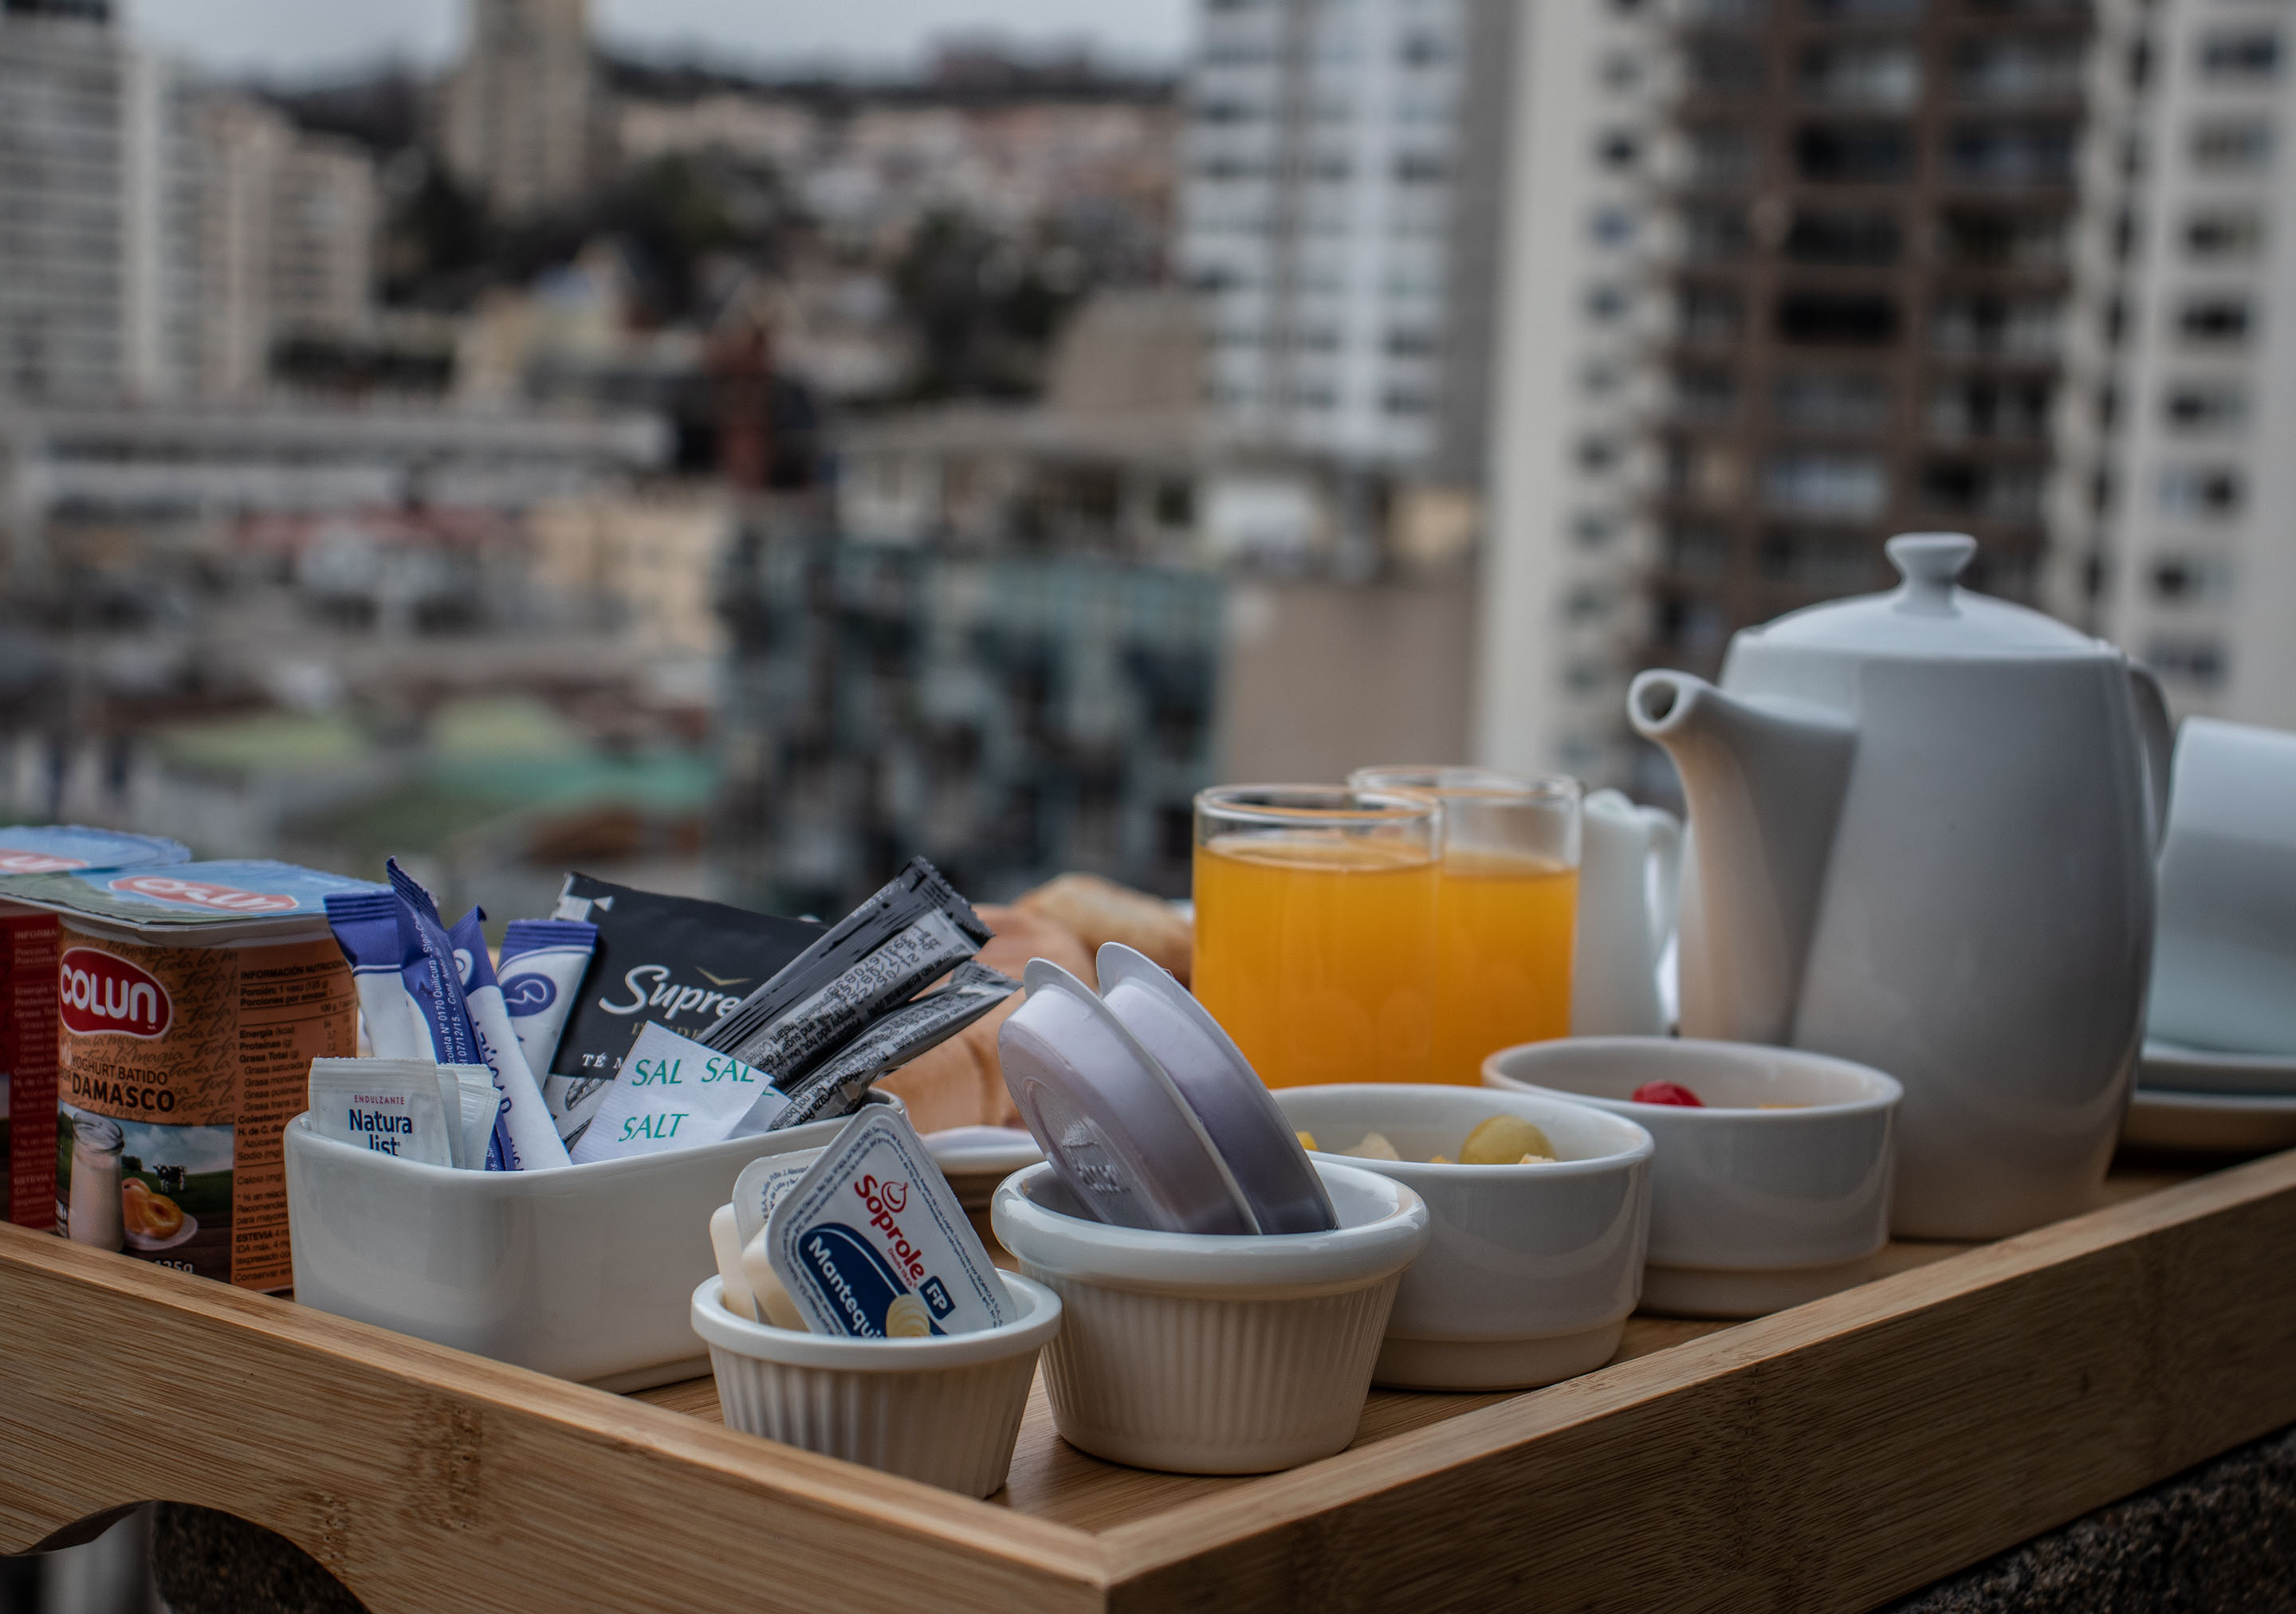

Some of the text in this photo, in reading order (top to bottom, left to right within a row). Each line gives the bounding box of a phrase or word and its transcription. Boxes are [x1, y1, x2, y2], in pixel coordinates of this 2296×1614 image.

[14, 929, 57, 940] INFORMA
[241, 966, 303, 980] INFORMACIÓN
[429, 960, 443, 999] Quilicura
[61, 964, 156, 1023] COLUN
[240, 986, 276, 996] Porción:
[240, 998, 284, 1007] Porciones
[434, 999, 448, 1022] 0170
[239, 1027, 273, 1039] Energía
[769, 1020, 799, 1046] Instant
[798, 1020, 818, 1039] and
[776, 1029, 802, 1053] sugar
[239, 1054, 266, 1063] Grasa
[268, 1051, 288, 1060] Total
[582, 1052, 606, 1068] TÉ
[743, 1039, 774, 1066] Coffee
[72, 1053, 118, 1079] YOGHURT
[119, 1066, 167, 1085] BATIDO
[244, 1066, 269, 1075] Grasa
[631, 1058, 682, 1086] SAL
[702, 1057, 755, 1083] SAL
[244, 1078, 269, 1087] Grasa
[72, 1072, 175, 1113] DAMASCO
[244, 1090, 269, 1100] Grasa
[354, 1094, 405, 1105] ENDULZANTE
[810, 1082, 843, 1113] Lavazza
[244, 1102, 269, 1111] Grasa
[793, 1093, 812, 1112] not
[238, 1111, 282, 1124] Colesterol
[348, 1109, 413, 1134] Natura
[618, 1113, 689, 1142] SALT
[369, 1133, 399, 1157] list
[237, 1151, 262, 1161] Sodio
[237, 1175, 264, 1185] Calcio
[854, 1174, 926, 1277] Soprole
[236, 1230, 273, 1242] ESTEVIA
[926, 1282, 948, 1310] FP
